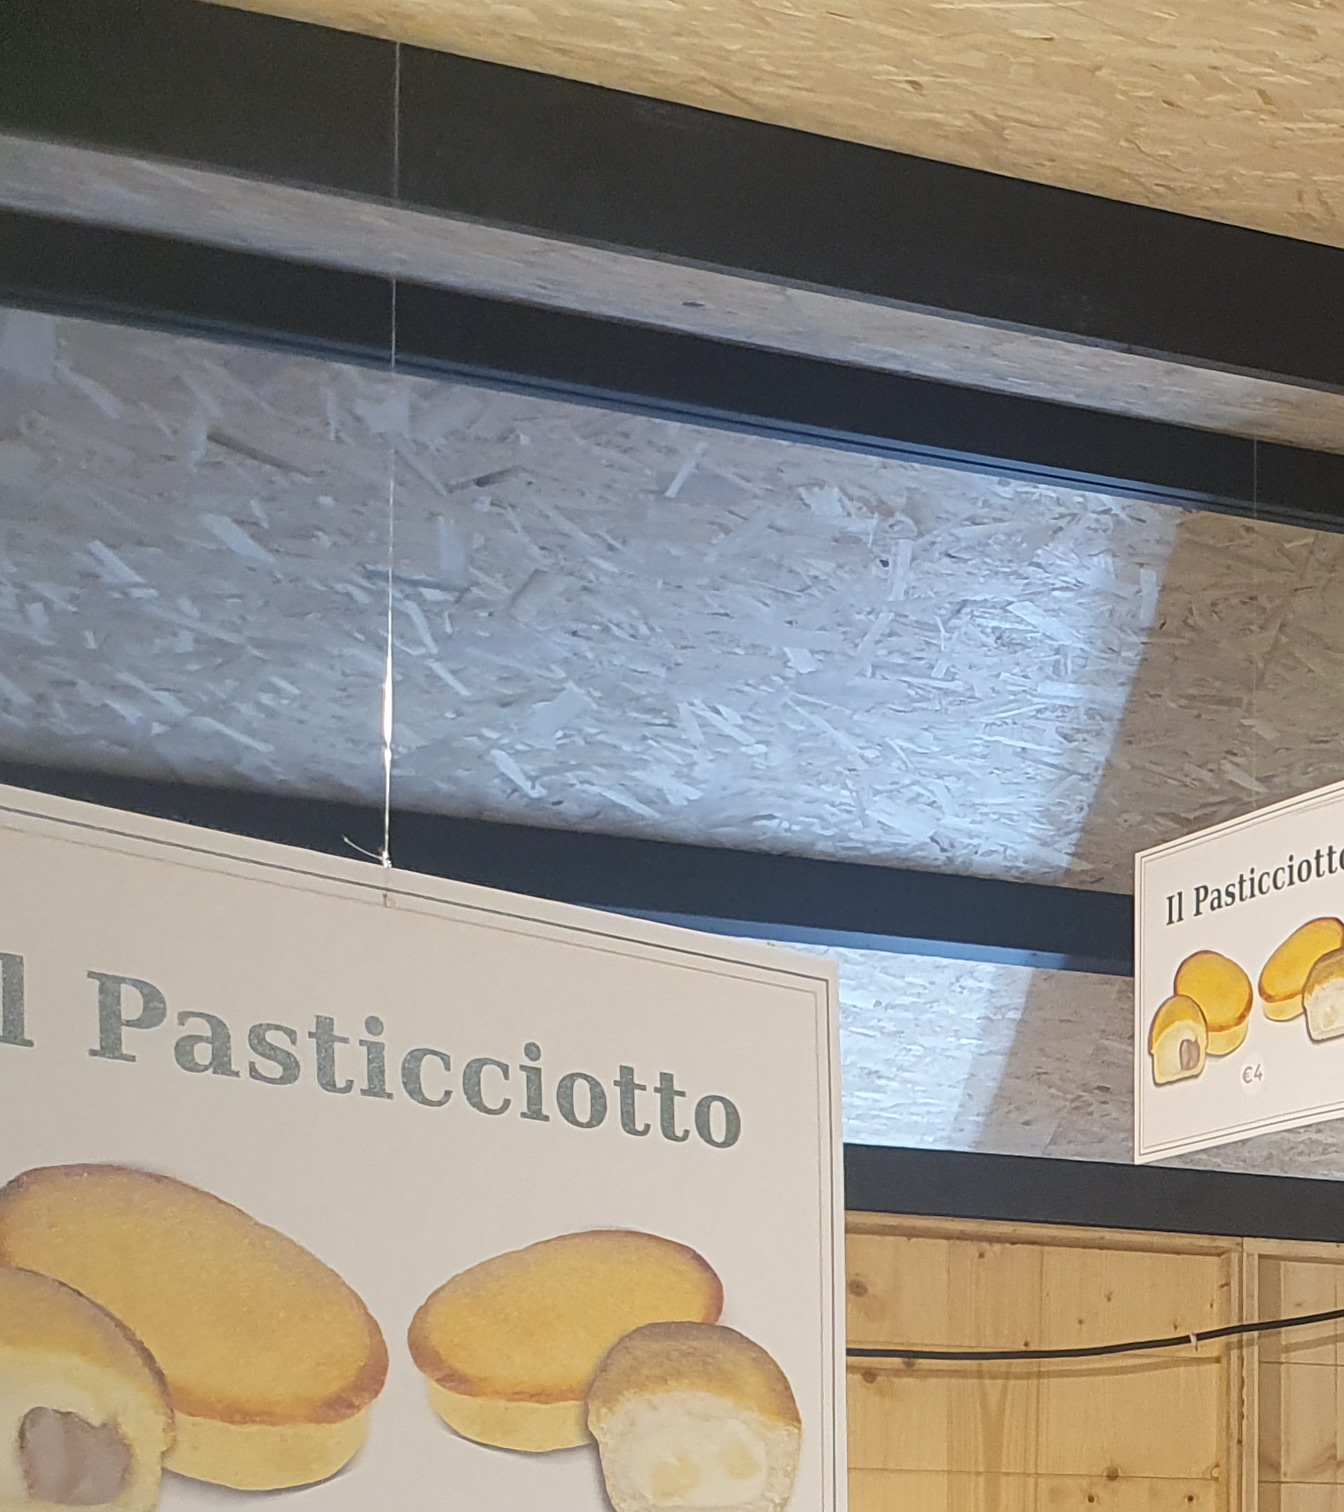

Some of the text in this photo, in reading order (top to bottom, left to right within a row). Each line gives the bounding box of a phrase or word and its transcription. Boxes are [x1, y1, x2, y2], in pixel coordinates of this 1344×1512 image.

[1166, 890, 1185, 926] Il
[0, 952, 742, 1149] l Pasticciotto
[1242, 1063, 1263, 1084] €4
